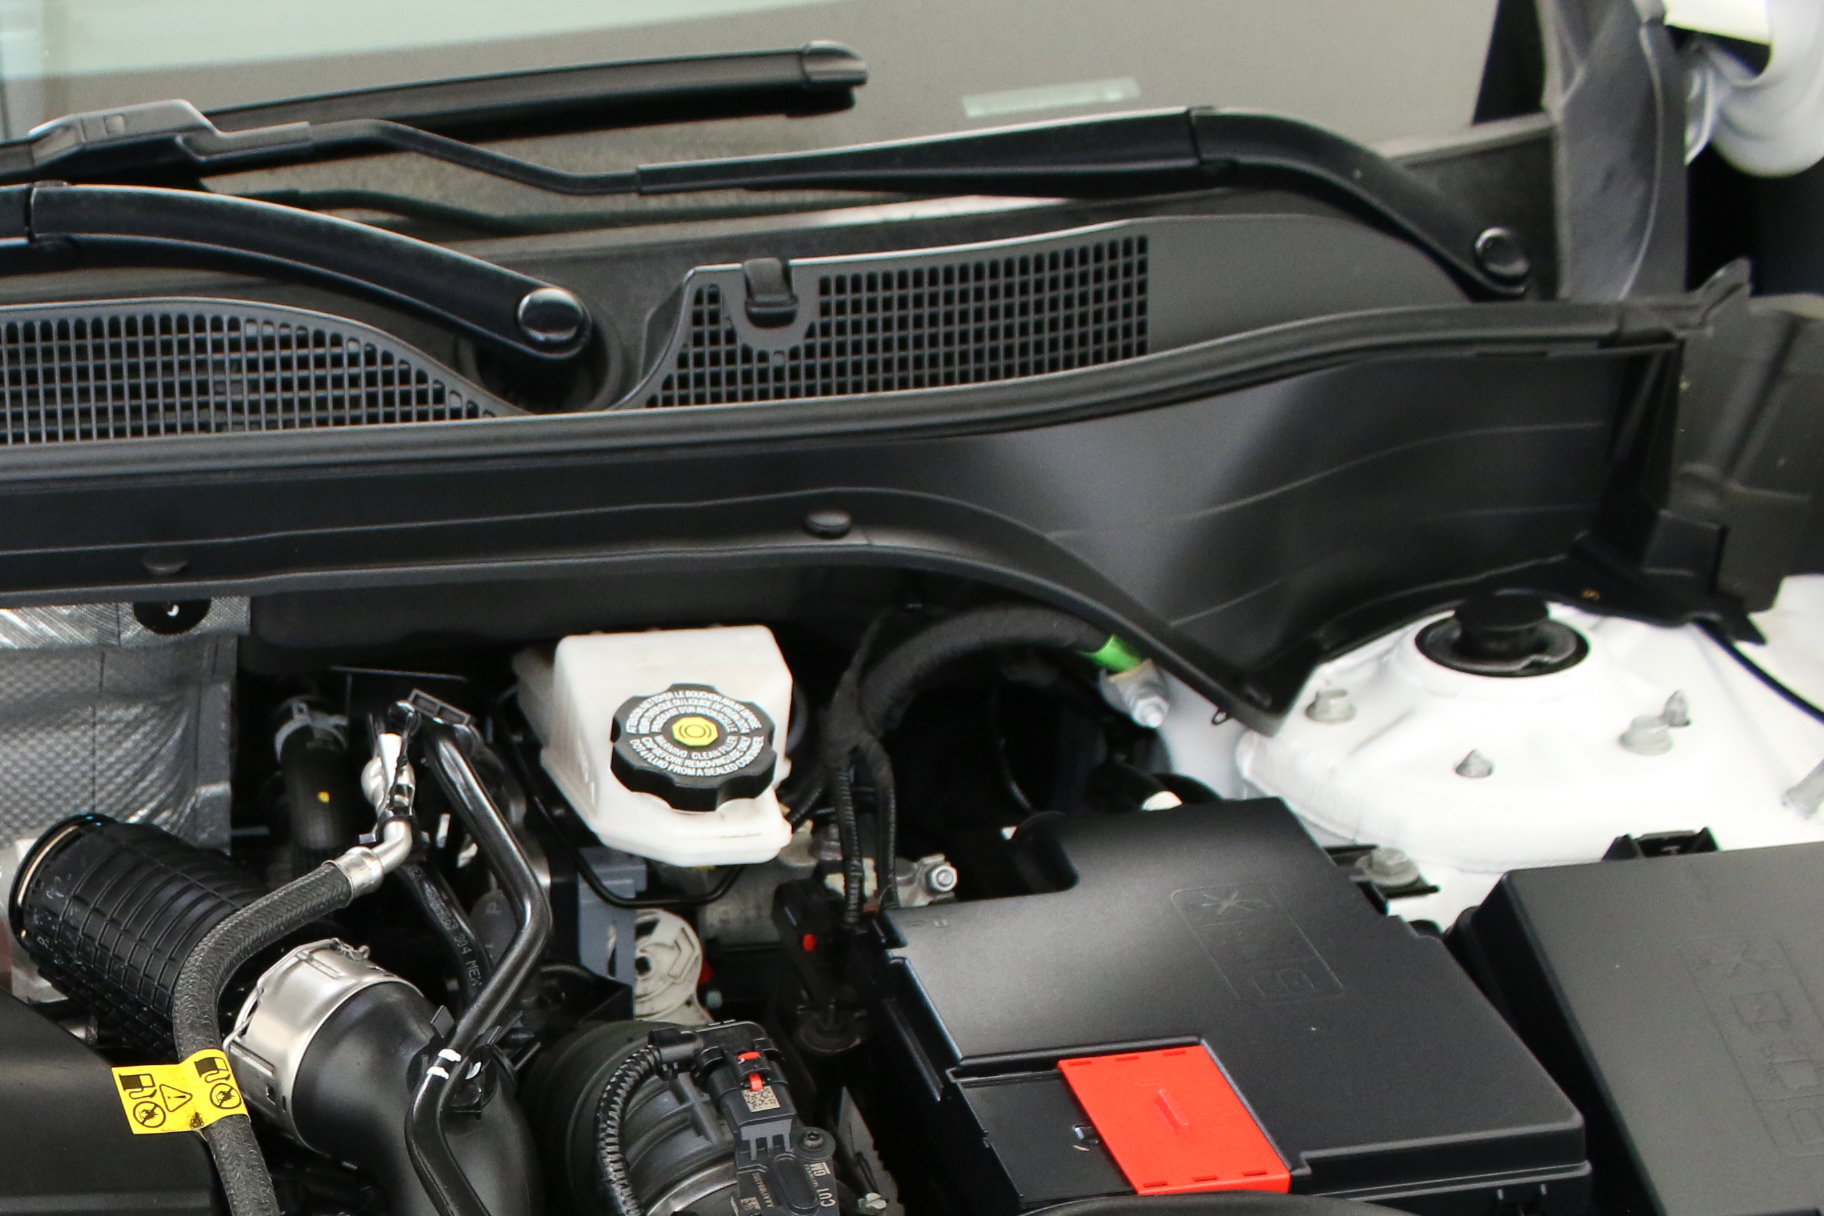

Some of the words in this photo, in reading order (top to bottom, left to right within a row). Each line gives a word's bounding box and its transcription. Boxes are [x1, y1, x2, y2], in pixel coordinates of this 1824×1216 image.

[691, 749, 722, 760] CLEAN
[667, 764, 696, 776] FROM
[696, 768, 704, 776] A
[704, 762, 738, 776] SEALED
[808, 1161, 831, 1178] GM
